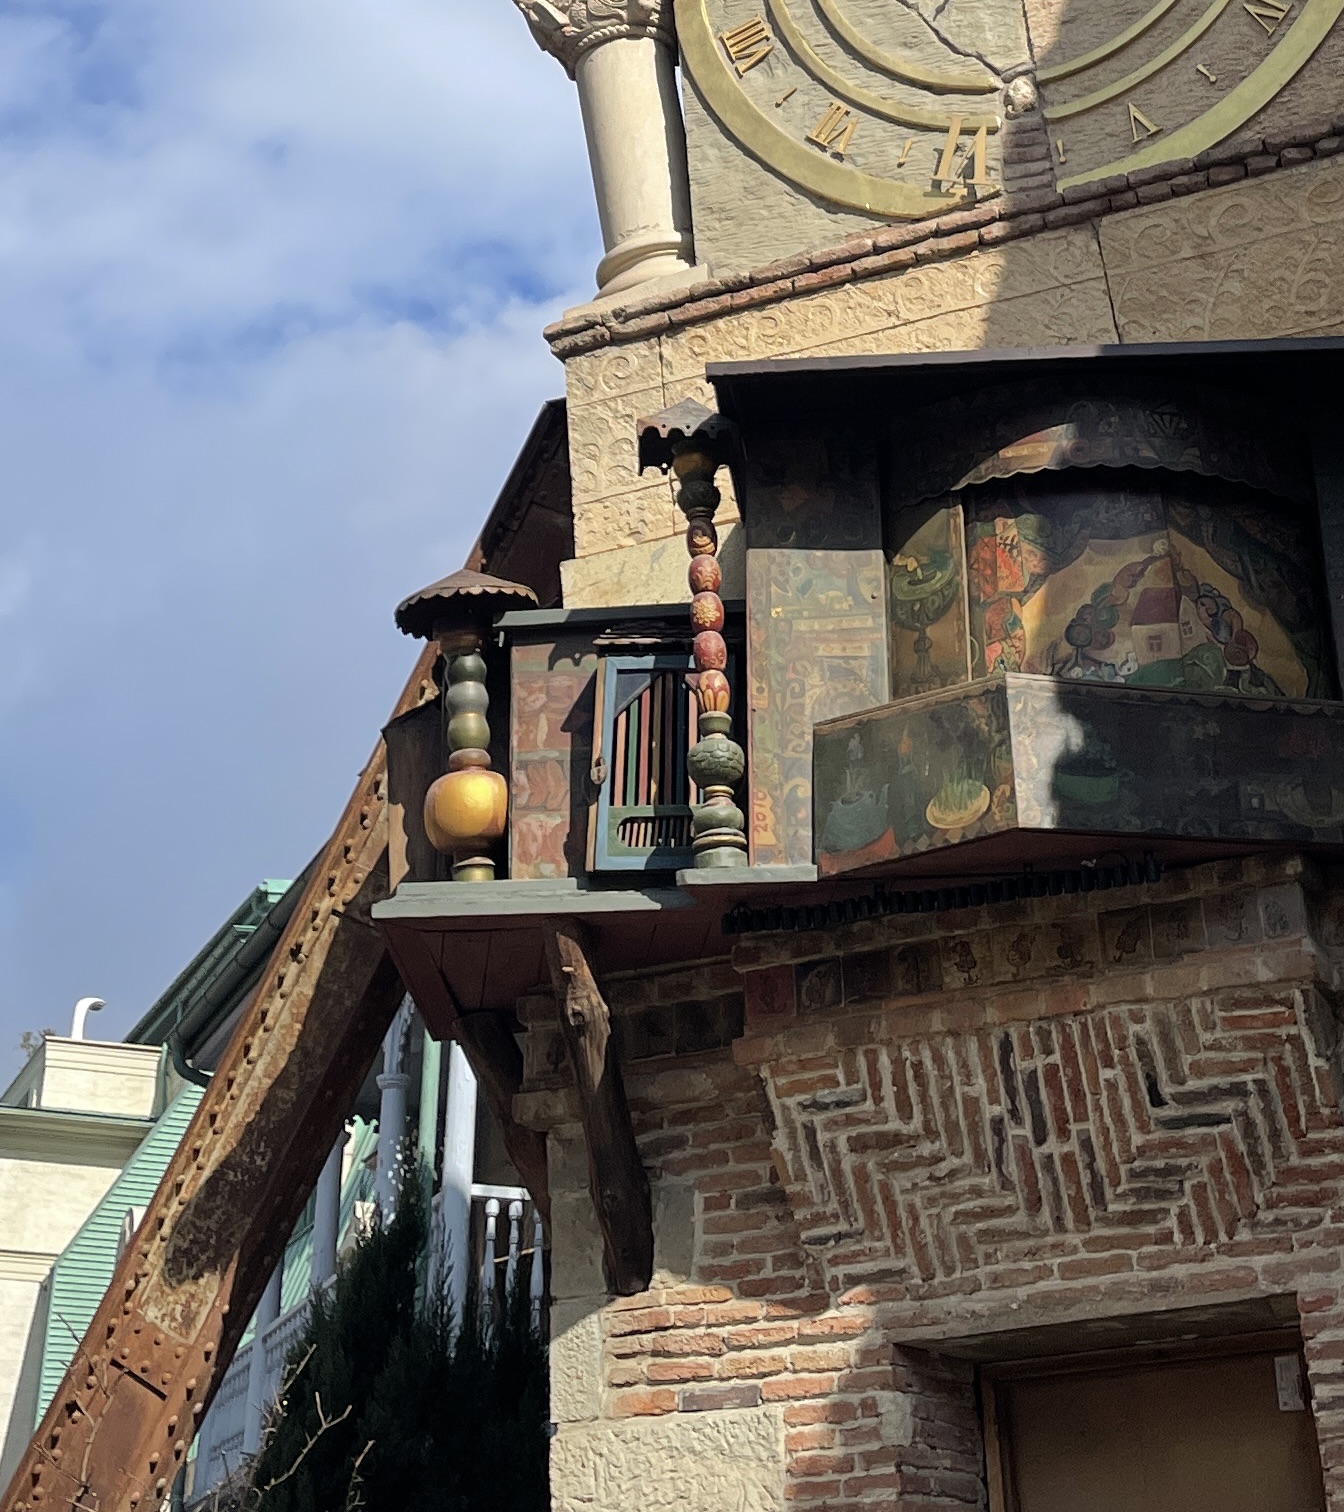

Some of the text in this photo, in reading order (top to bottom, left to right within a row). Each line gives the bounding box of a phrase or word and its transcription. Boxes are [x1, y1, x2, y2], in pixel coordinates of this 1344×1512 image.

[719, 14, 775, 75] VIII
[805, 102, 859, 155] VII
[1128, 101, 1163, 143] V
[930, 115, 1000, 190] VI
